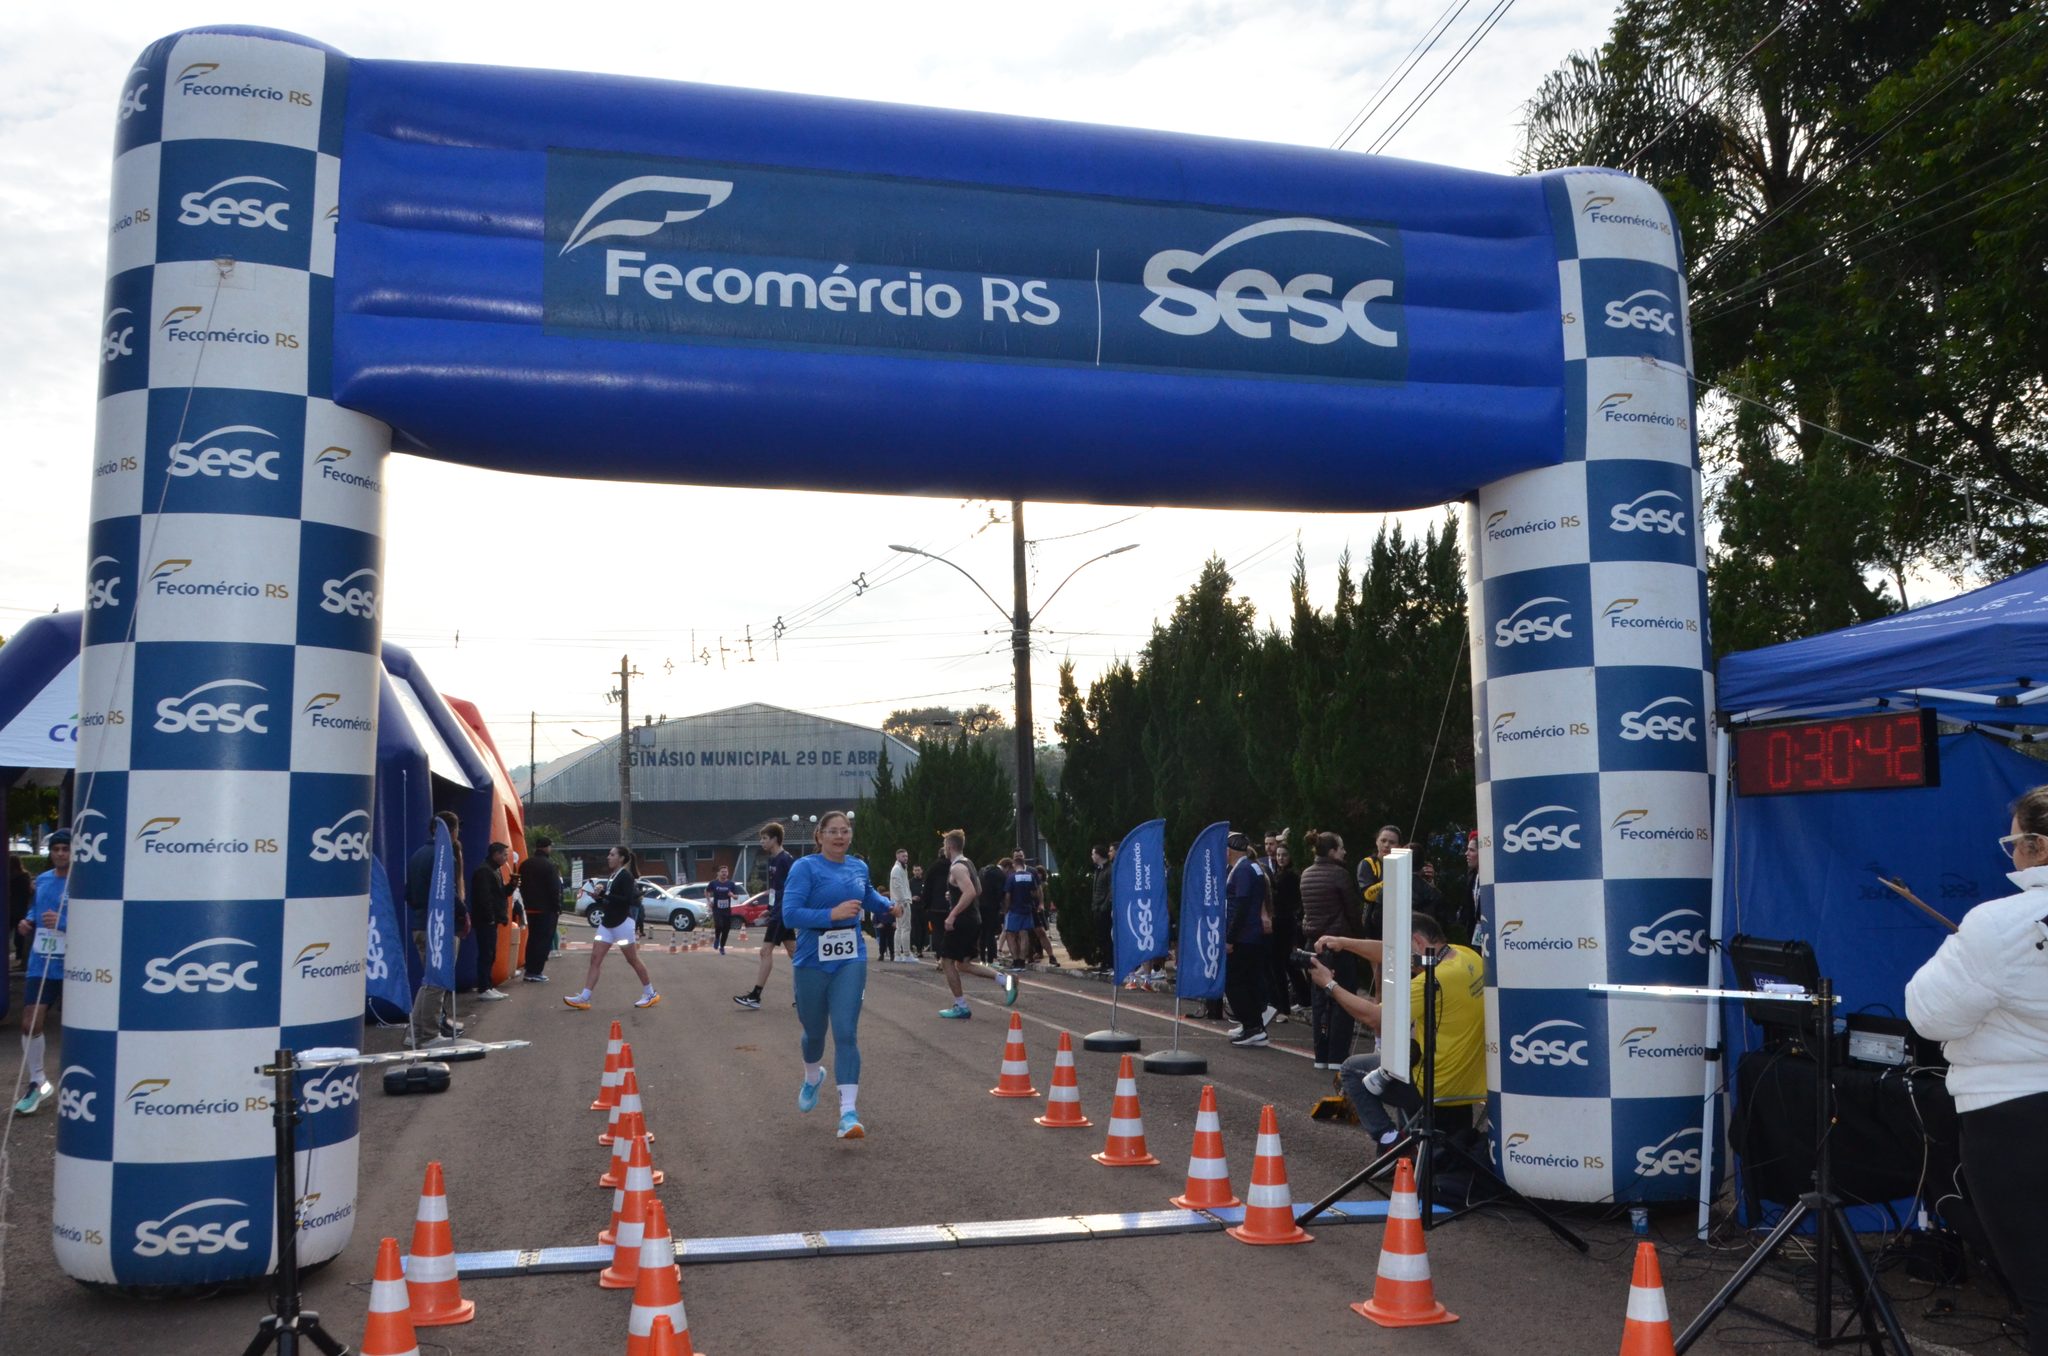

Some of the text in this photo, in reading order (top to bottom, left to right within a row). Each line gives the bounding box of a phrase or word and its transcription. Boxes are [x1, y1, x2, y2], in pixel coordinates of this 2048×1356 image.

[183, 82, 313, 107] Fecomércio RS
[135, 208, 151, 224] RS
[178, 192, 290, 232] Sesc
[1592, 212, 1659, 230] Fecomércio
[606, 247, 1398, 348] Fecomércio RS Sesc
[1604, 300, 1676, 336] Sesc
[168, 328, 300, 349] Fecomércio RS
[1605, 410, 1688, 431] Fecomércio RS
[120, 456, 138, 471] RS
[166, 442, 280, 481] Sesc
[1488, 515, 1581, 541] Fecomércio RS
[1609, 503, 1686, 537] Sesc
[87, 576, 121, 611] esc
[156, 580, 289, 599] Fecomércio RS
[1495, 613, 1573, 648] Sesc
[1611, 616, 1684, 631] Fecomércio
[1686, 619, 1698, 632] RS
[108, 710, 125, 725] RS
[153, 697, 269, 734] Sesc
[1619, 711, 1697, 742] Sesc
[1496, 725, 1565, 743] Fecomércio
[1569, 722, 1590, 737] RS
[629, 748, 695, 767] GINÁSIO
[701, 750, 791, 767] MUNICIPAL
[796, 750, 816, 766] 29
[822, 750, 842, 766] DE
[145, 838, 279, 854] Fecomércio RS
[1502, 823, 1581, 853] Sesc
[1620, 827, 1708, 841] Fecomércio RS
[71, 832, 108, 863] esc
[1137, 898, 1155, 951] Sesc
[432, 908, 445, 970] Sesc
[822, 940, 854, 956] 963
[1204, 915, 1220, 980] Sesc
[1504, 938, 1573, 951] Fecomércio
[1578, 937, 1598, 950] RS
[1628, 926, 1707, 956] Sesc
[96, 969, 112, 983] RS
[142, 957, 259, 994] Sesc
[1509, 1035, 1589, 1066] Sesc
[1628, 1043, 1704, 1058] Fecomércio
[58, 1087, 96, 1123] esc
[134, 1095, 268, 1116] Fecomércio RS
[1509, 1151, 1579, 1169] Fecomércio
[1583, 1156, 1604, 1169] RS
[1634, 1146, 1714, 1177] Ses
[85, 1229, 103, 1245] RS
[133, 1219, 249, 1257] Sesc
